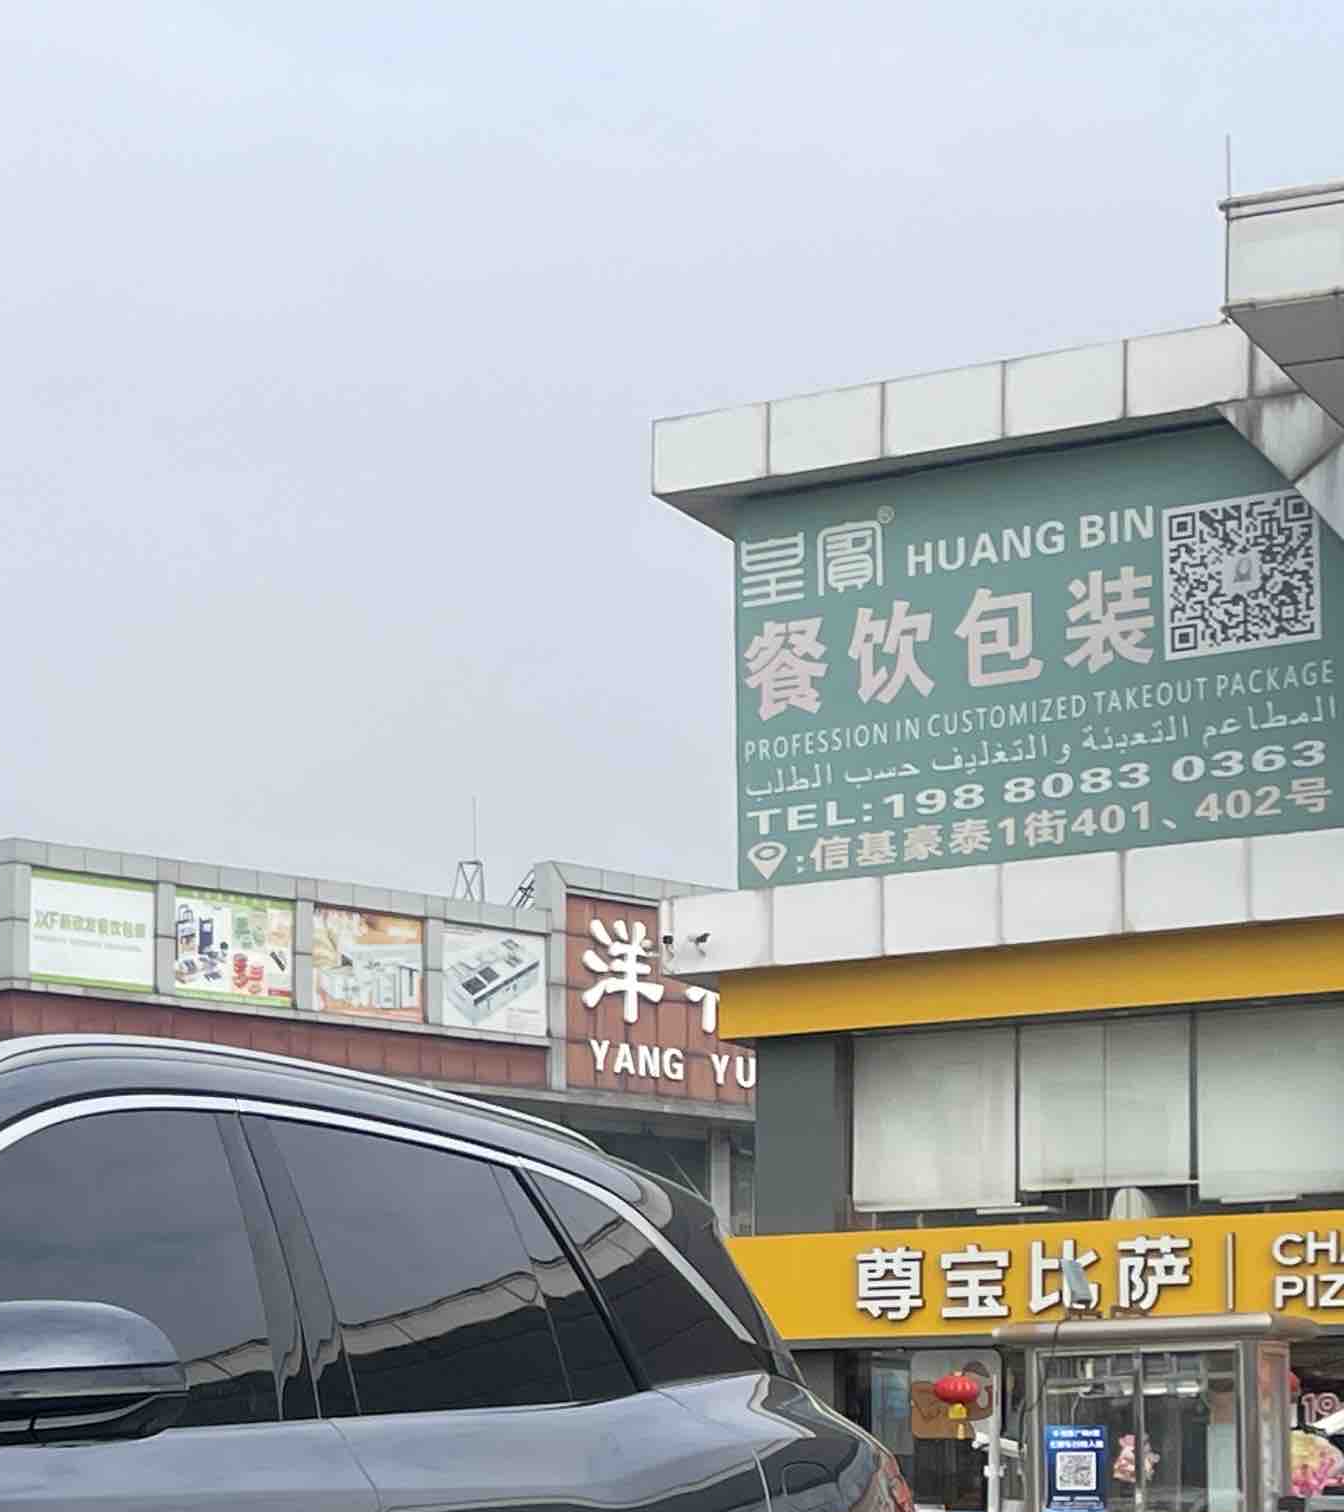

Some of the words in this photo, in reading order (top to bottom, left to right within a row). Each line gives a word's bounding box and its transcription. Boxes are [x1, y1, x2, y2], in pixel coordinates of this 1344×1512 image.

[907, 520, 1065, 578] HUANG
[1079, 505, 1155, 550] BIN
[742, 564, 1156, 722] 餐饮包装
[744, 722, 889, 763] PROFESSION
[896, 717, 920, 742] IN
[927, 694, 1088, 737] CUSTOMIZED
[1092, 676, 1209, 715] TAKEOUT
[1216, 658, 1335, 698] PACKAGE
[1002, 761, 1152, 803] 8083
[1170, 739, 1327, 783] 0363
[581, 918, 720, 1034] 洋
[589, 1038, 685, 1081] YANG
[710, 1054, 757, 1089] YU
[855, 1234, 1193, 1321] 尊宝比萨
[1272, 1230, 1344, 1266] CH
